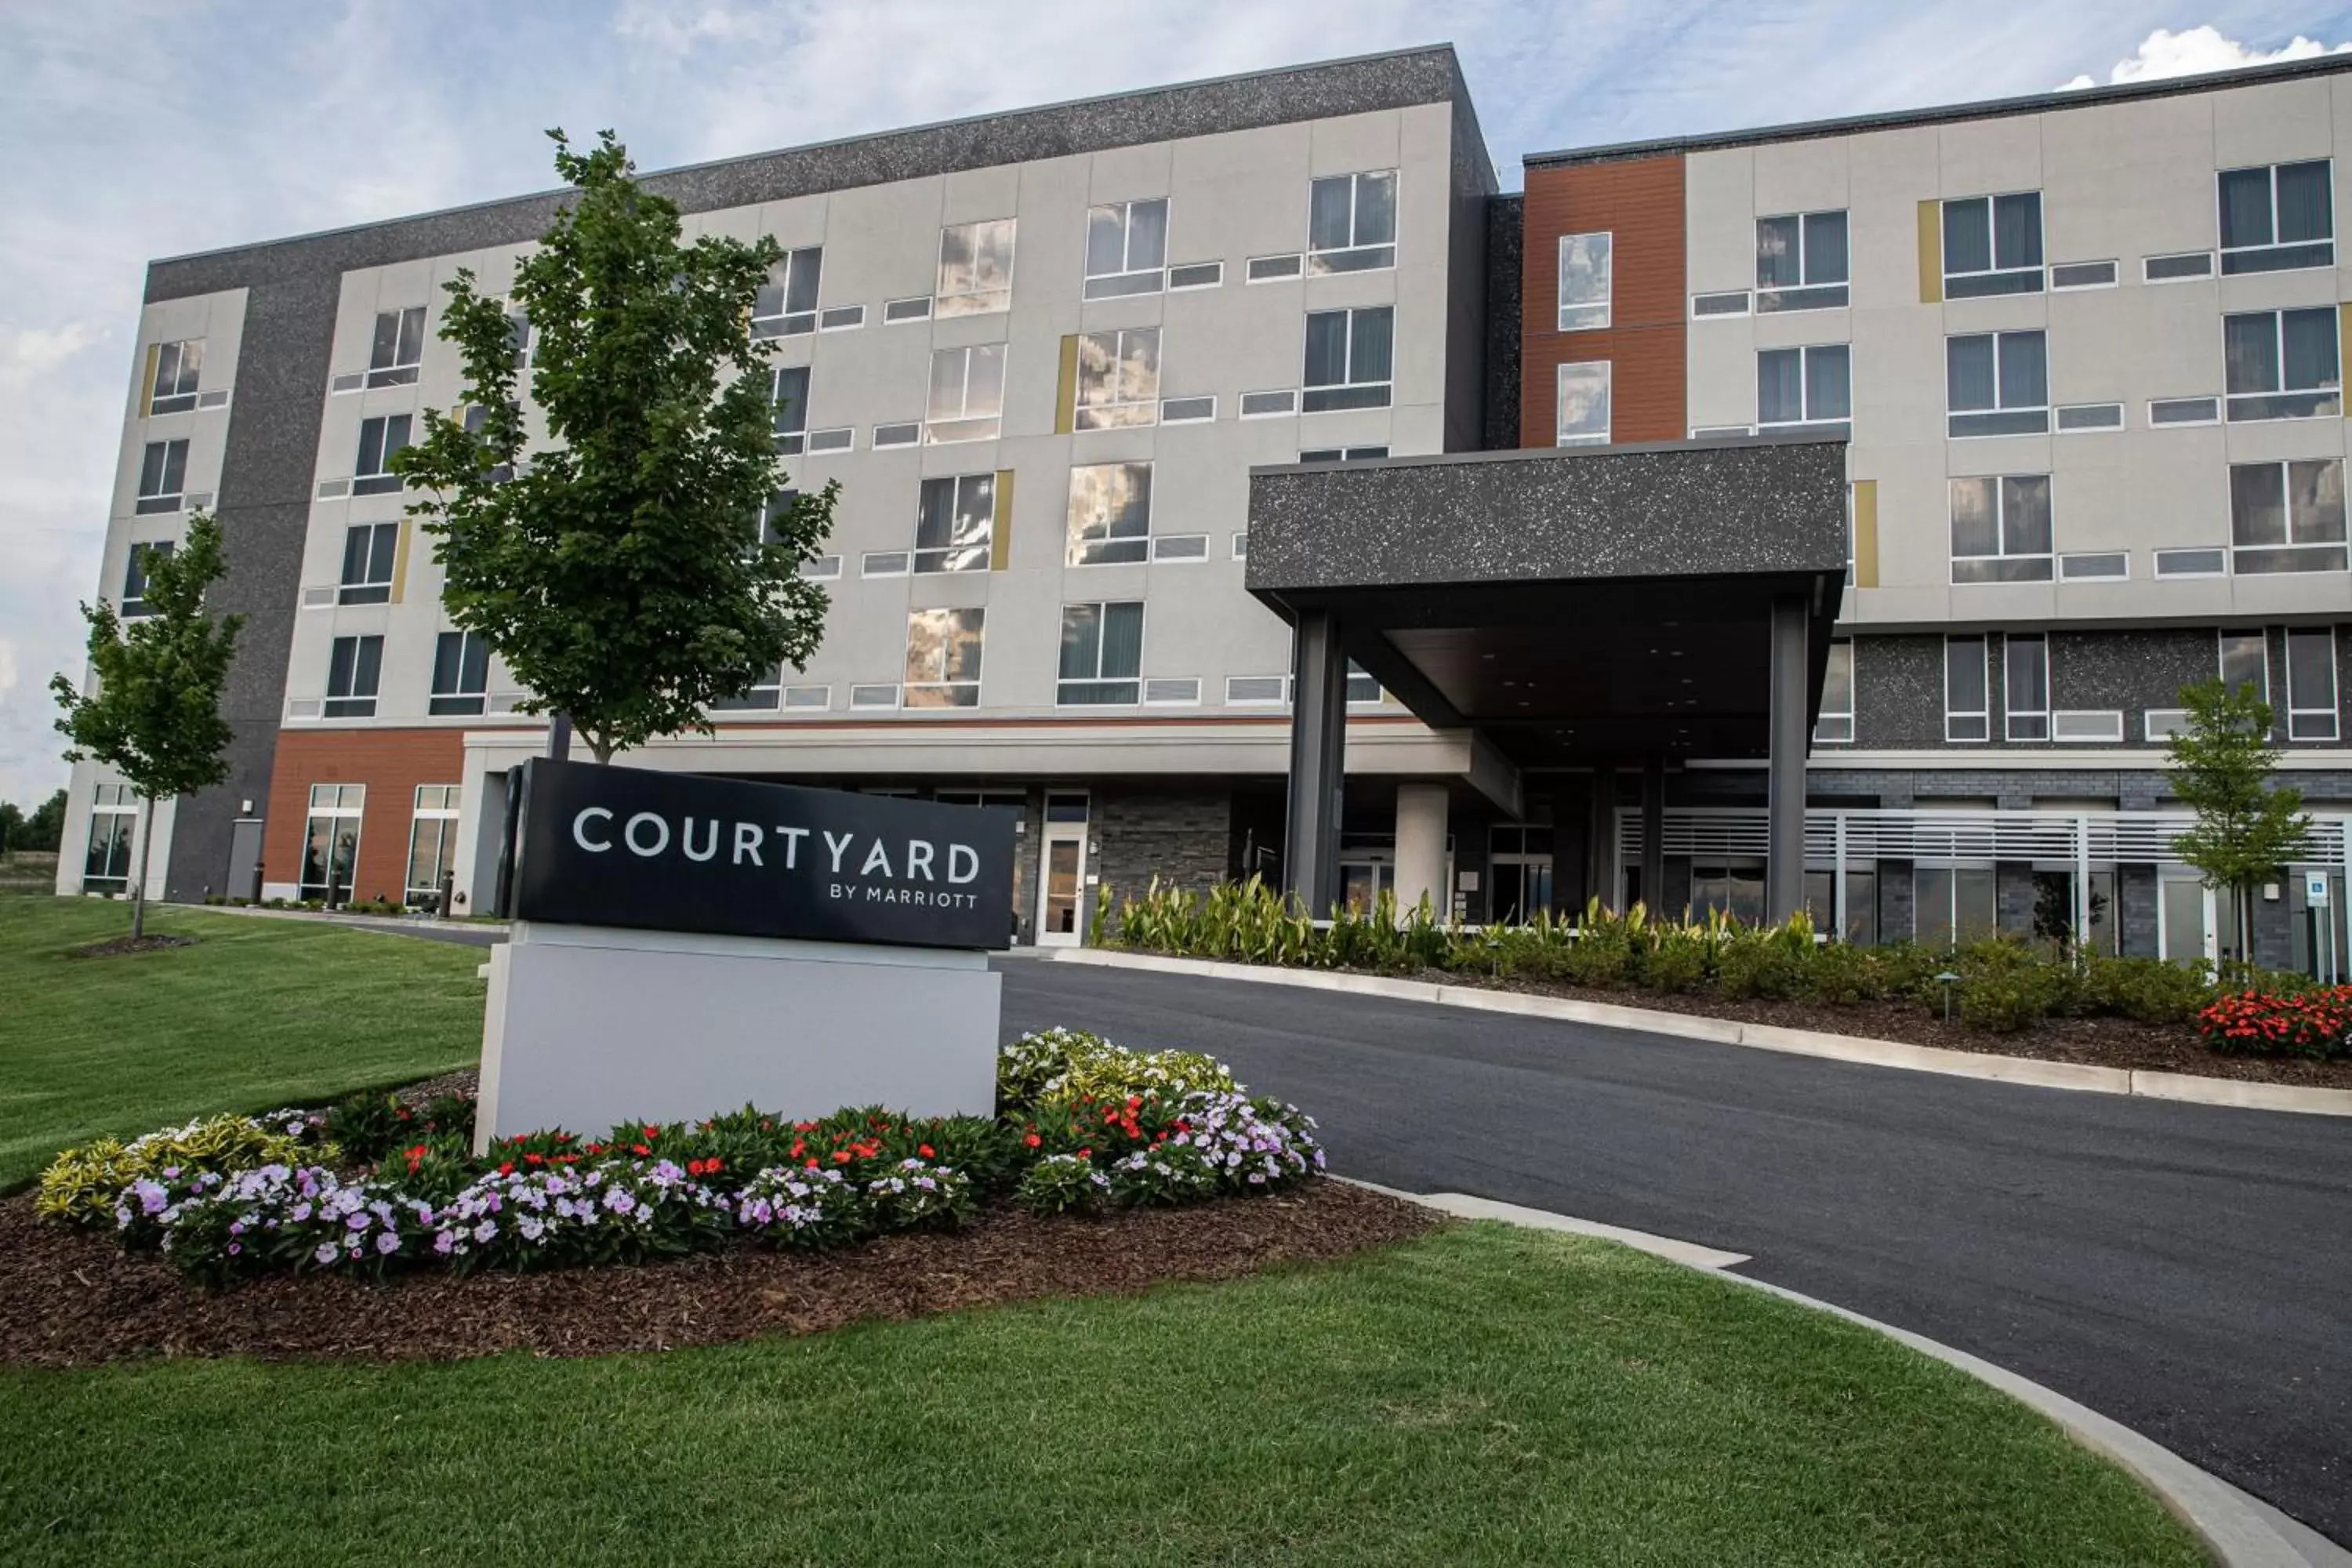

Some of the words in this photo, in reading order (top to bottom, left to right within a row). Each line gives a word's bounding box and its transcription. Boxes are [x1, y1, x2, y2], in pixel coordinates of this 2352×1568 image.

[573, 807, 979, 884] COURTYARD
[830, 884, 857, 899] BY
[866, 887, 978, 909] MARRIOTT
